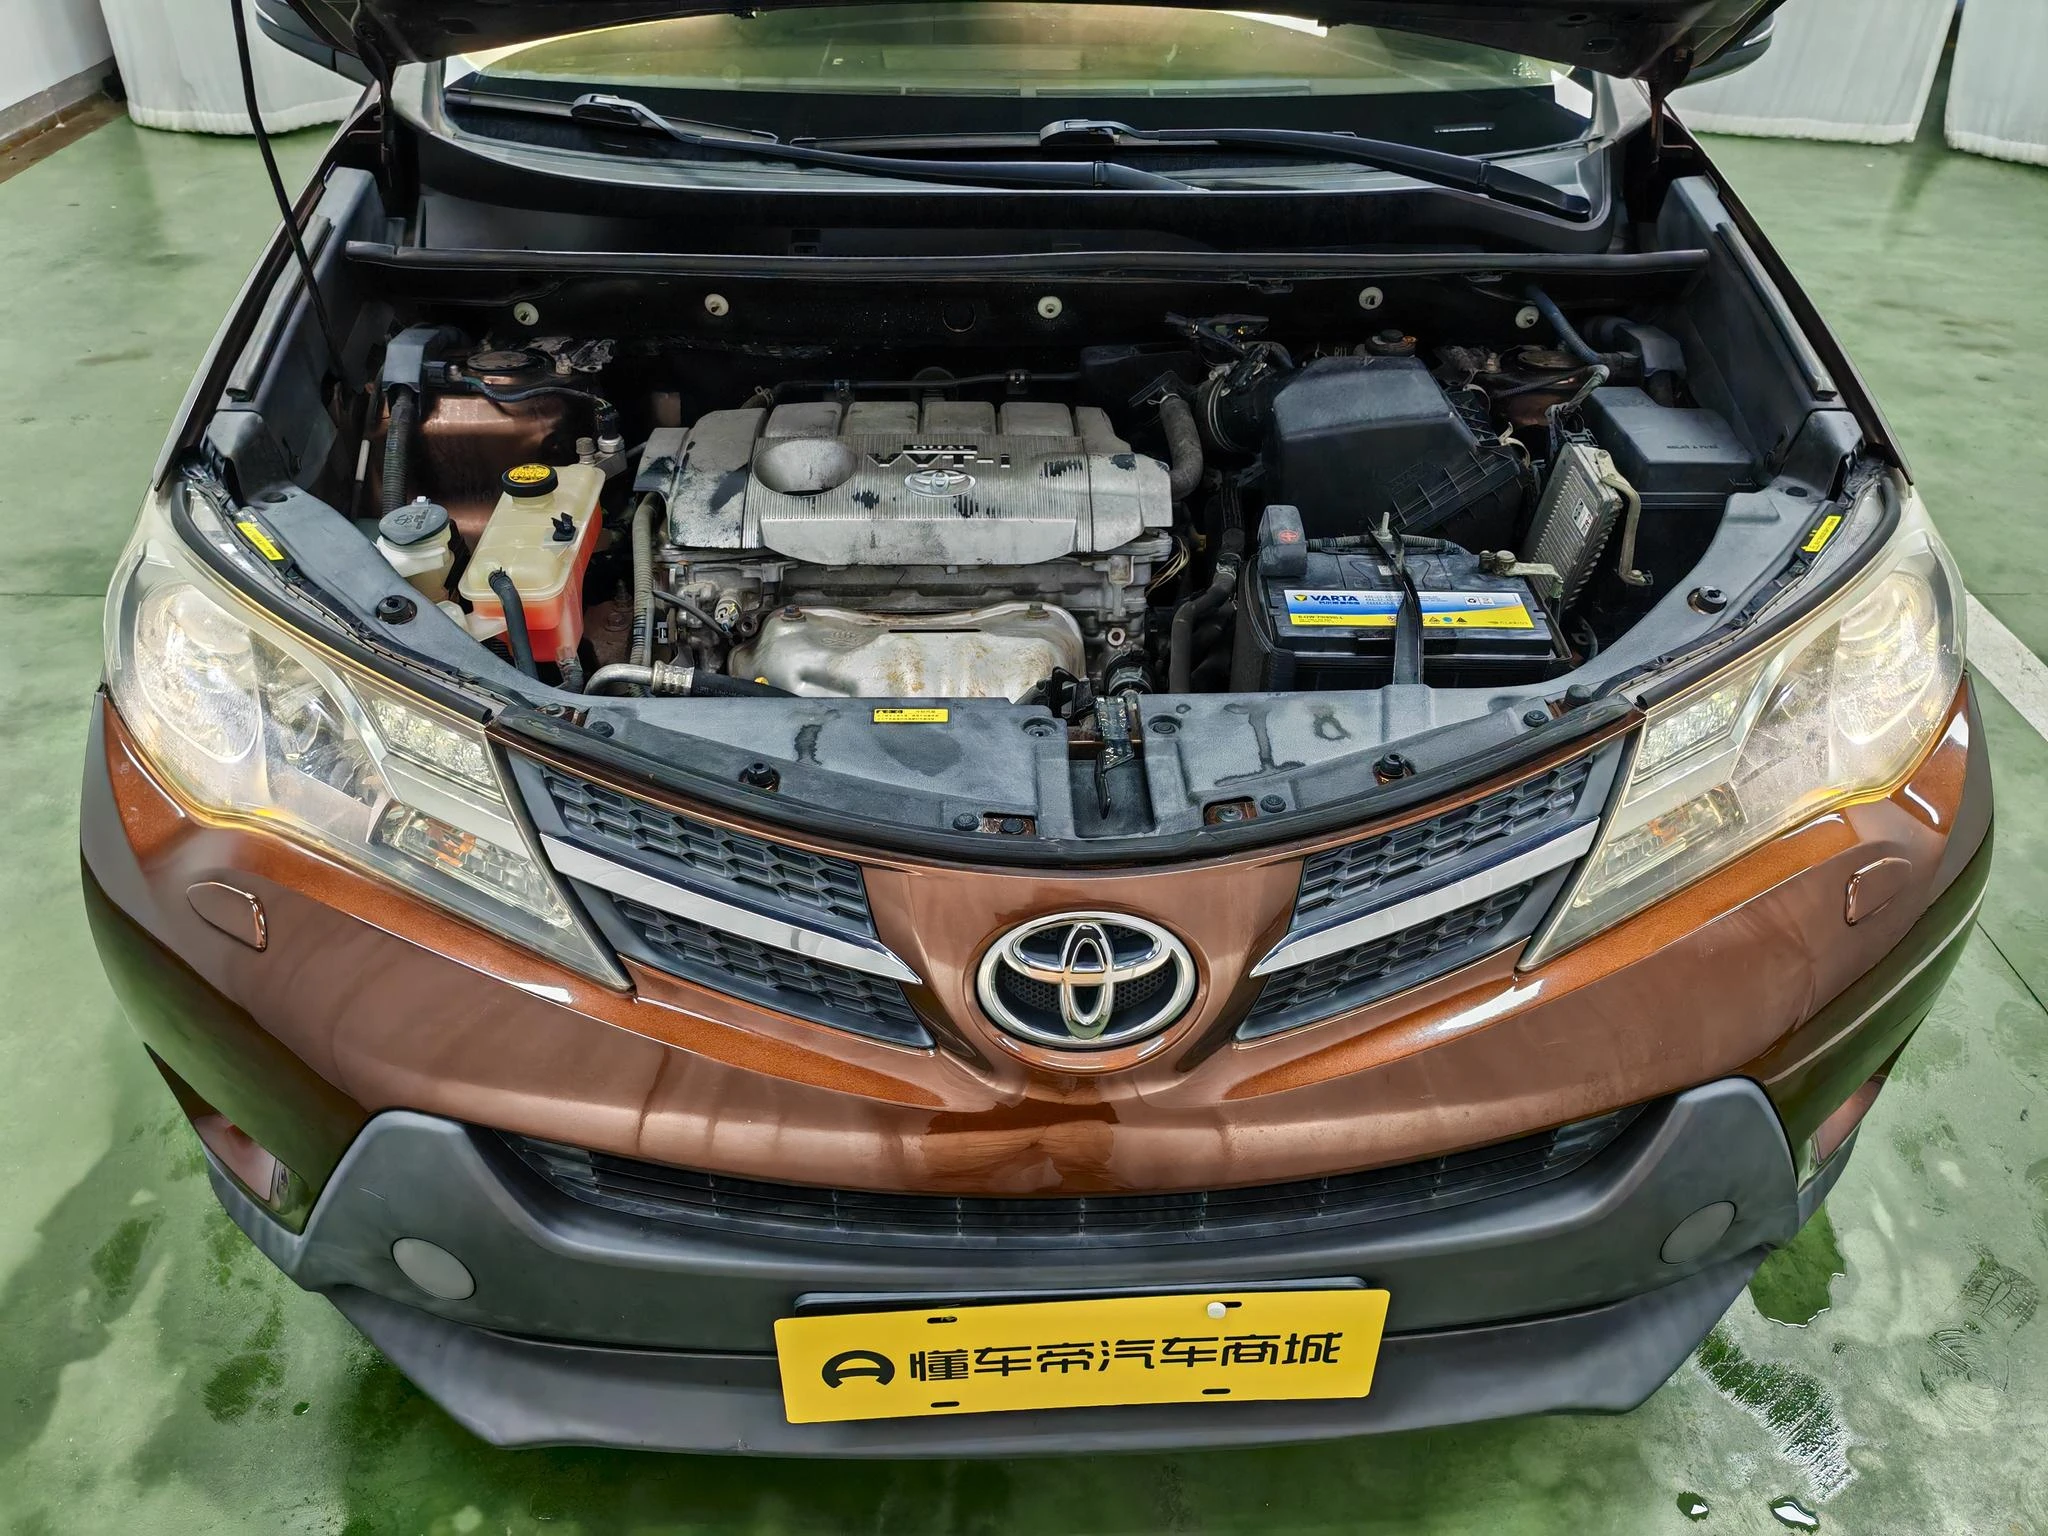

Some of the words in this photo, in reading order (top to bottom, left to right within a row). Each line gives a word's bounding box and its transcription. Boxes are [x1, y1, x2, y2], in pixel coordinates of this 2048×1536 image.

[910, 1333, 1343, 1382] 懂车帝汽车商城
